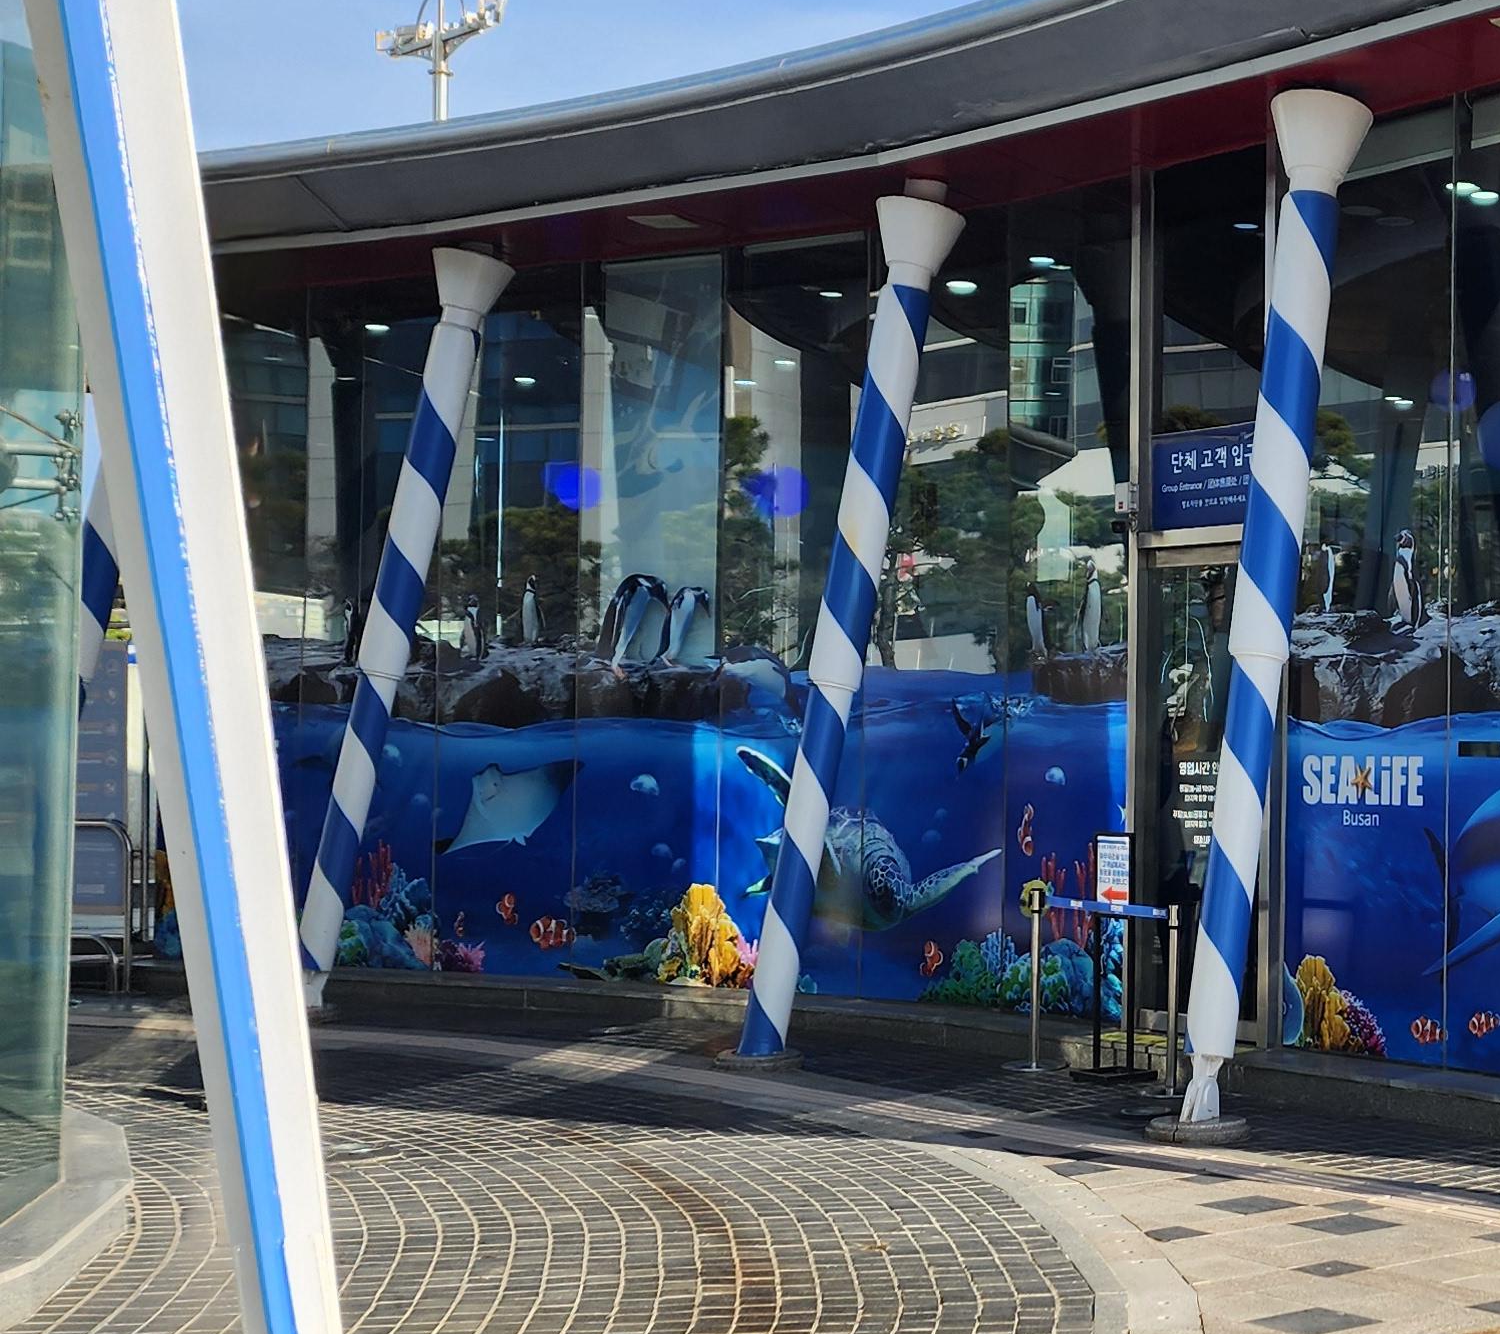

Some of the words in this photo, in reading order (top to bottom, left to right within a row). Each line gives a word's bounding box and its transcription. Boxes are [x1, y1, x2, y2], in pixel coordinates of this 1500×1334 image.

[1171, 449, 1197, 474] 단체
[1200, 445, 1227, 469] 고객
[1161, 483, 1178, 493] Group
[1179, 481, 1203, 491] Entrance
[1302, 754, 1358, 805] SEA
[1342, 809, 1380, 827] Busan
